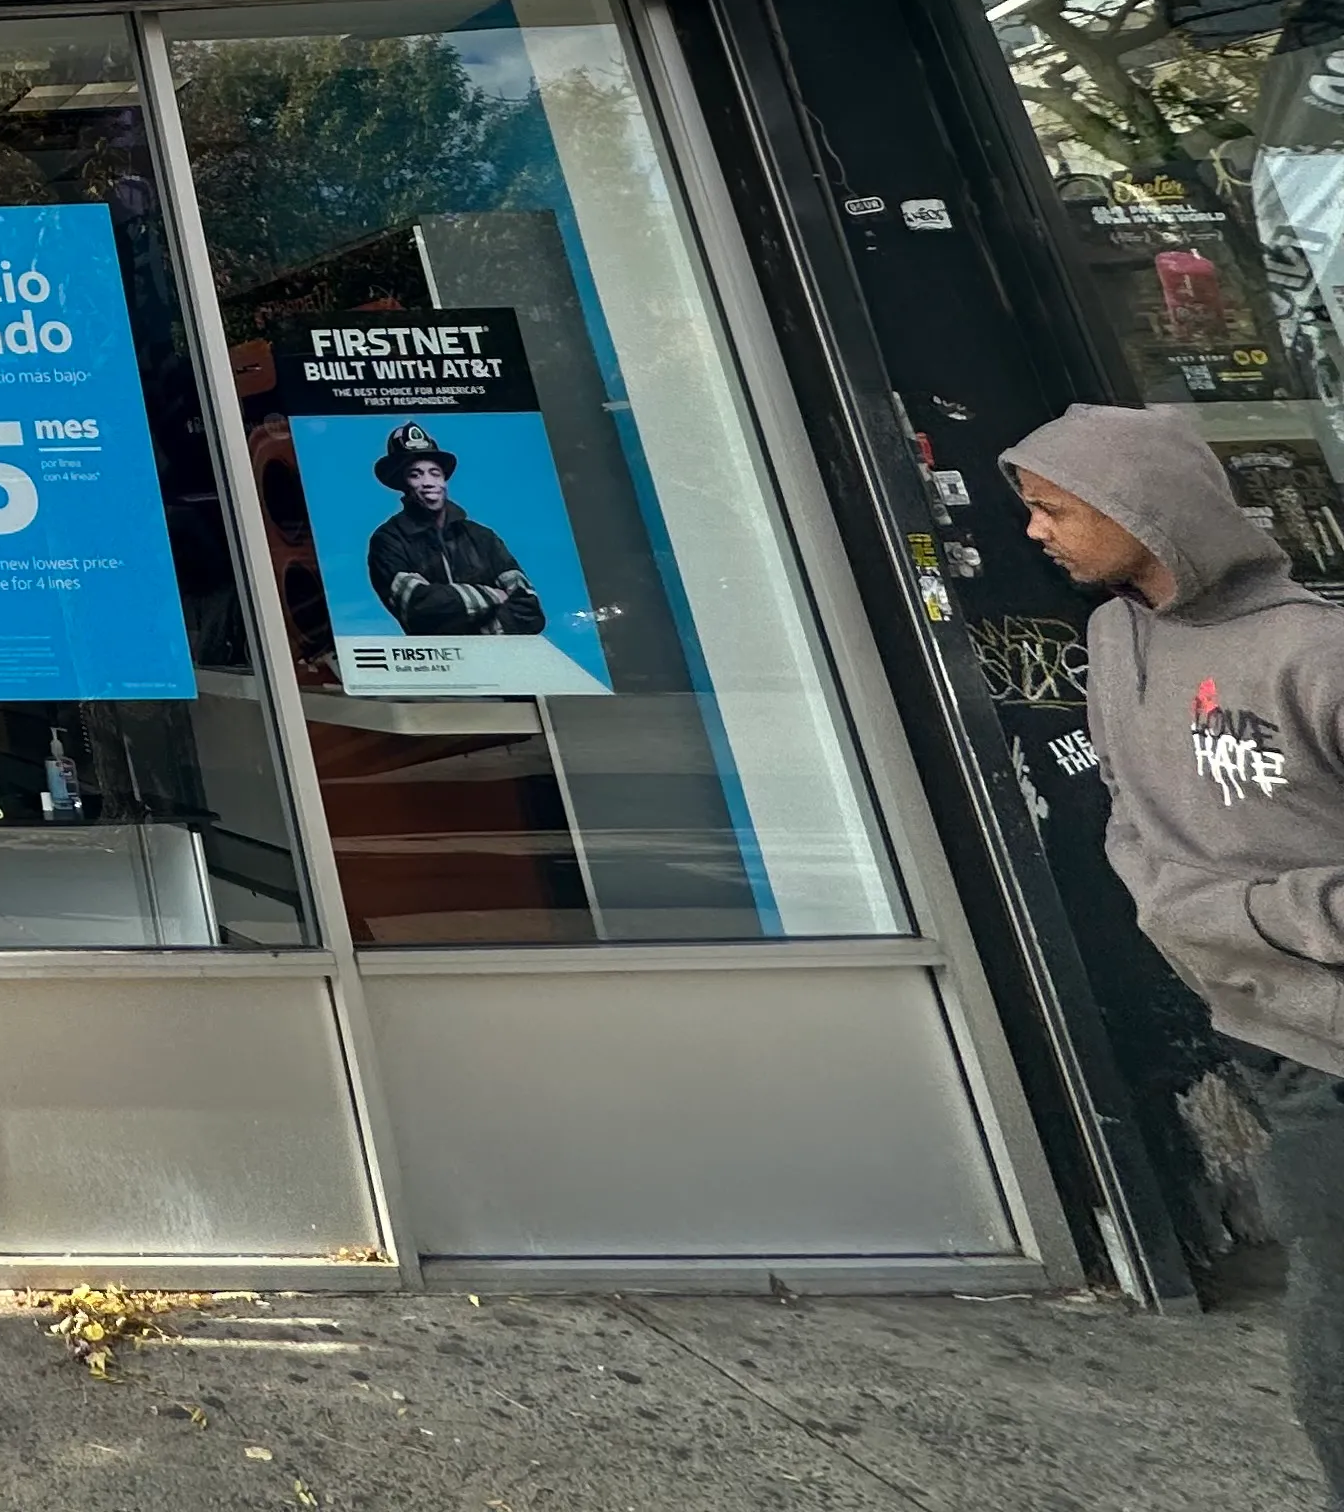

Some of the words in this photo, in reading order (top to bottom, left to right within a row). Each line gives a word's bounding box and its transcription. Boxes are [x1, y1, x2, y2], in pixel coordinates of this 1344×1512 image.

[18, 369, 51, 384] más
[303, 361, 365, 381] BUILT
[371, 360, 436, 380] WITH
[442, 358, 502, 378] AT&T
[332, 388, 352, 397] THE
[354, 388, 377, 396] BEST
[380, 387, 412, 396] CHOICE
[414, 386, 433, 395] FOR
[364, 397, 391, 405] FIRST
[34, 418, 100, 439] mes
[41, 460, 57, 469] por
[43, 473, 61, 481] con
[62, 472, 69, 480] 4
[0, 560, 30, 571] new
[32, 556, 78, 570] lowest
[11, 577, 32, 590] for
[36, 576, 45, 589] 4
[48, 576, 81, 590] lines
